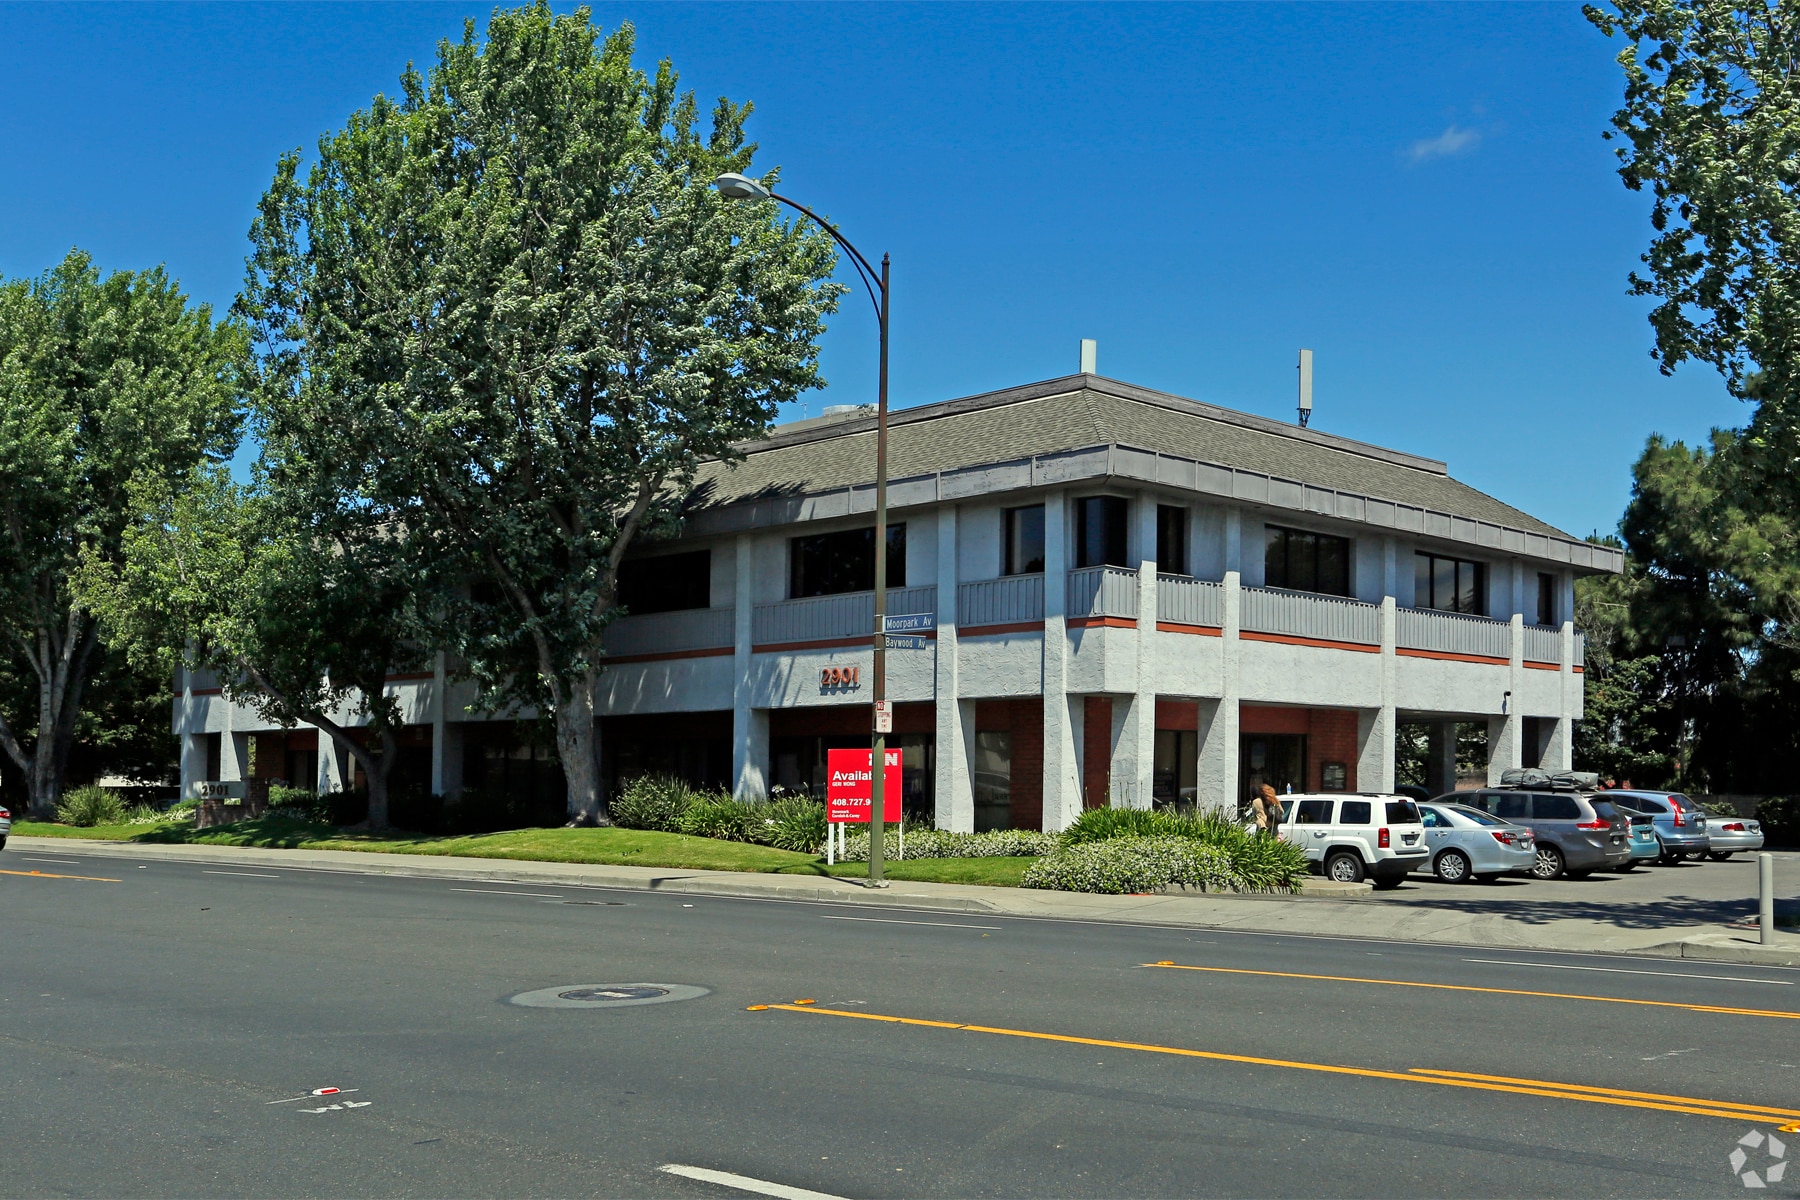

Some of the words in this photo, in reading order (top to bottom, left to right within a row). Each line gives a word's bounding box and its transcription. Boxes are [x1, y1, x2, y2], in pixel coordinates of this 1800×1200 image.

[886, 617, 919, 629] Moorpark
[922, 616, 932, 626] Av
[885, 637, 913, 649] Baywood
[917, 639, 926, 649] Av
[821, 667, 859, 684] 2901
[832, 770, 886, 781] Availa
[202, 785, 229, 796] 2901
[832, 798, 885, 806] 408.727.9
